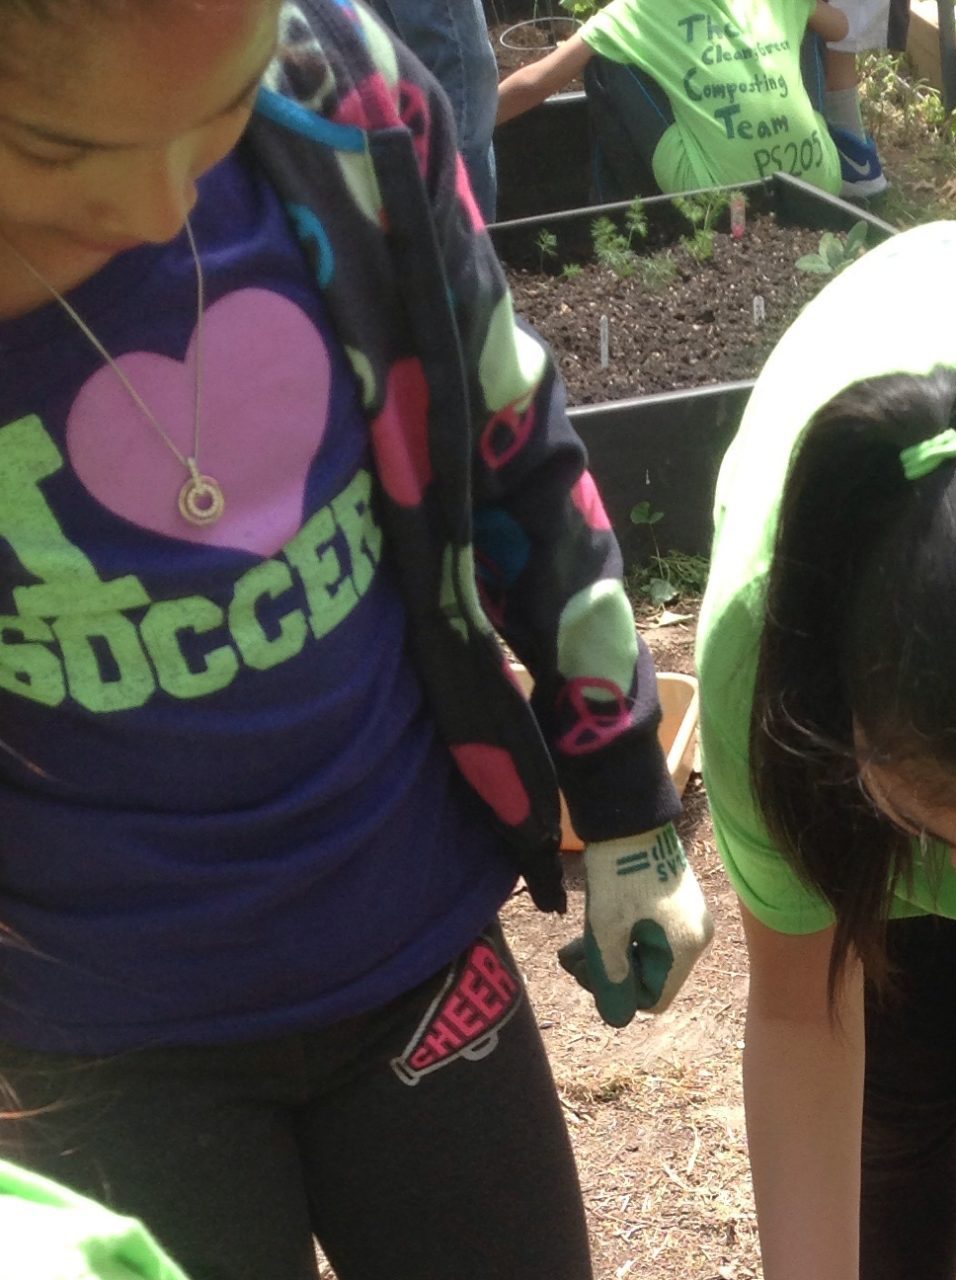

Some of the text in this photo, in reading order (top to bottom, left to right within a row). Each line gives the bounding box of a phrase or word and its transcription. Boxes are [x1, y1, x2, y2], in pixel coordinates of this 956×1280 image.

[677, 13, 740, 43] The
[684, 67, 789, 103] Composting
[714, 104, 789, 140] Team
[754, 129, 823, 178] PS205
[0, 413, 152, 618] I
[0, 469, 383, 713] SOCCER
[408, 941, 519, 1070] CHEER
